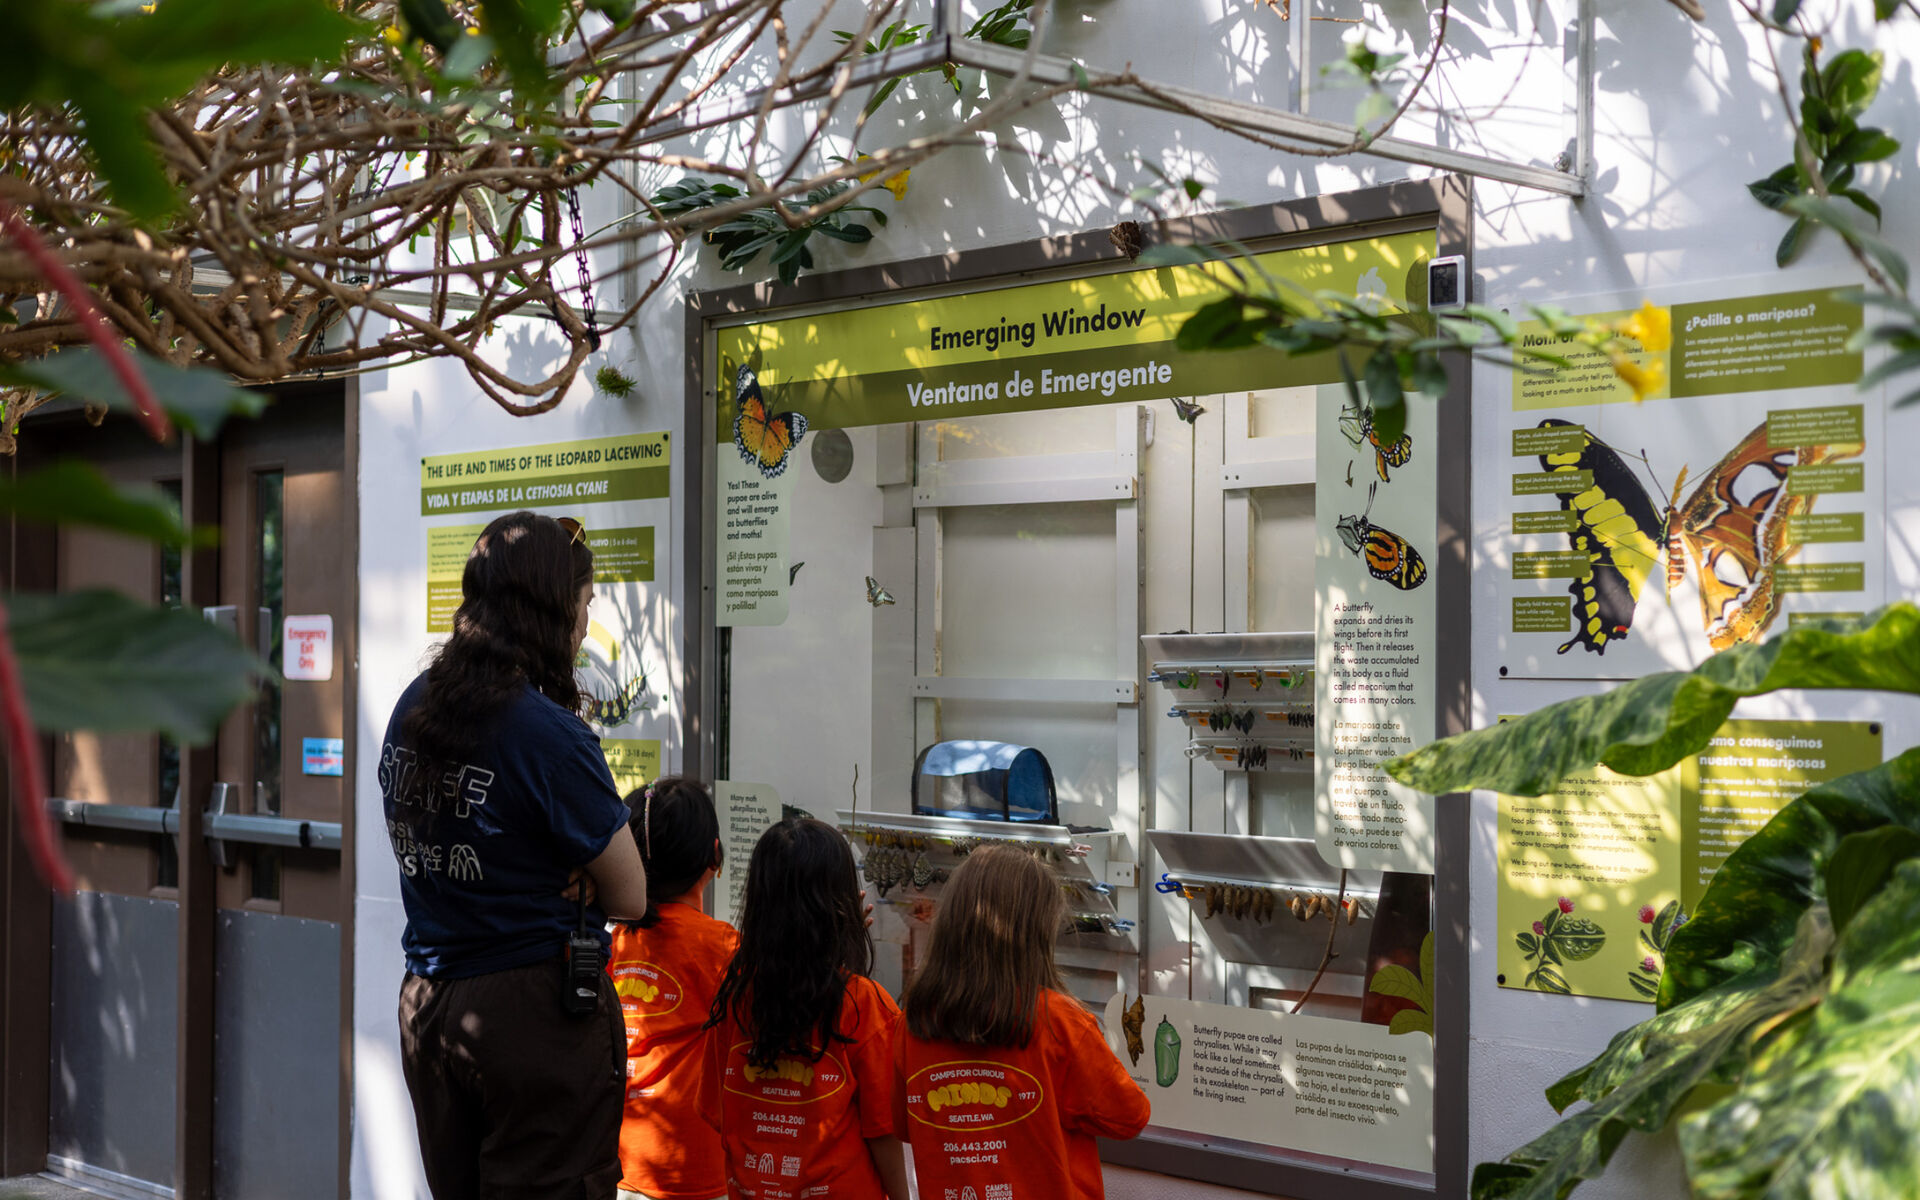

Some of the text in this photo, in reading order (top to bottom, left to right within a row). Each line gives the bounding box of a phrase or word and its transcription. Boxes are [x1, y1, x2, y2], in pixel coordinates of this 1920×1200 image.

[1685, 304, 1816, 332] ¿Polilla o mariposa?
[930, 303, 1146, 352] Emerging Window
[906, 360, 1172, 407] Ventana de Emergente
[427, 443, 662, 479] THE LIFE AND TIMES OF THE LEOPARD LACEWING
[728, 480, 759, 489] Yes! These
[427, 480, 608, 508] VIDA Y ETAPAS DE LA CETHOSIA CYANE
[727, 496, 747, 505] pupae
[761, 491, 777, 500] alive
[727, 505, 779, 515] and will emerge
[736, 517, 768, 527] butterflies
[727, 529, 762, 540] and moths!
[757, 552, 777, 561] pupas
[727, 562, 768, 574] están vivas y
[727, 575, 761, 587] emergerán
[745, 588, 778, 599] mariposas
[726, 604, 731, 612] y
[1334, 601, 1374, 613] A butterfly
[1334, 614, 1414, 627] expands and dries its
[288, 627, 327, 643] Emergency
[1334, 627, 1409, 640] wings before its first
[301, 641, 314, 655] Exit
[1334, 641, 1414, 654] flight. Then it releases
[298, 656, 315, 672] Only
[1334, 655, 1345, 664] the
[1371, 654, 1419, 664] accumulated
[1334, 669, 1340, 677] in
[1342, 669, 1350, 677] its
[1352, 668, 1372, 680] body
[1392, 668, 1409, 677] fluid
[1334, 681, 1413, 691] called meconium that
[1359, 695, 1365, 704] in
[1368, 697, 1388, 707] many
[1391, 695, 1416, 704] colors.
[1739, 736, 1823, 750] conseguimos
[1699, 755, 1826, 771] nuestras mariposas
[1334, 825, 1348, 835] nio,
[1350, 828, 1364, 836] que
[1366, 827, 1390, 837] puede
[1334, 837, 1399, 850] de varios colores.
[1511, 840, 1533, 848] window
[1542, 842, 1570, 851] complete
[1193, 1024, 1283, 1045] Butterfly pupae are called
[1193, 1037, 1277, 1059] chrysalises. While it may
[1296, 1039, 1407, 1063] Las pupas de las mariposas se
[1193, 1049, 1208, 1059] look
[1210, 1052, 1221, 1062] like
[1230, 1054, 1243, 1065] leaf
[1244, 1059, 1282, 1072] sometimes,
[1296, 1052, 1407, 1077] denominan crisálidas. Aunque
[821, 1074, 840, 1083] 1977
[930, 1069, 1005, 1082] CAMPS FOR CURIOUS
[1193, 1062, 1283, 1084] the outside of the chrysalis
[1193, 1075, 1285, 1096] is its exoskeleton part of
[1018, 1091, 1036, 1100] 1977
[1193, 1087, 1246, 1104] the living insect.
[752, 1112, 805, 1125] 206.443.2001
[1296, 1105, 1314, 1115] parte
[1317, 1107, 1328, 1117] del
[1330, 1109, 1356, 1122] insecto
[757, 1125, 798, 1138] pacsci.org
[944, 1140, 1007, 1152] 206.443.2001
[950, 1153, 998, 1165] pacsci.org
